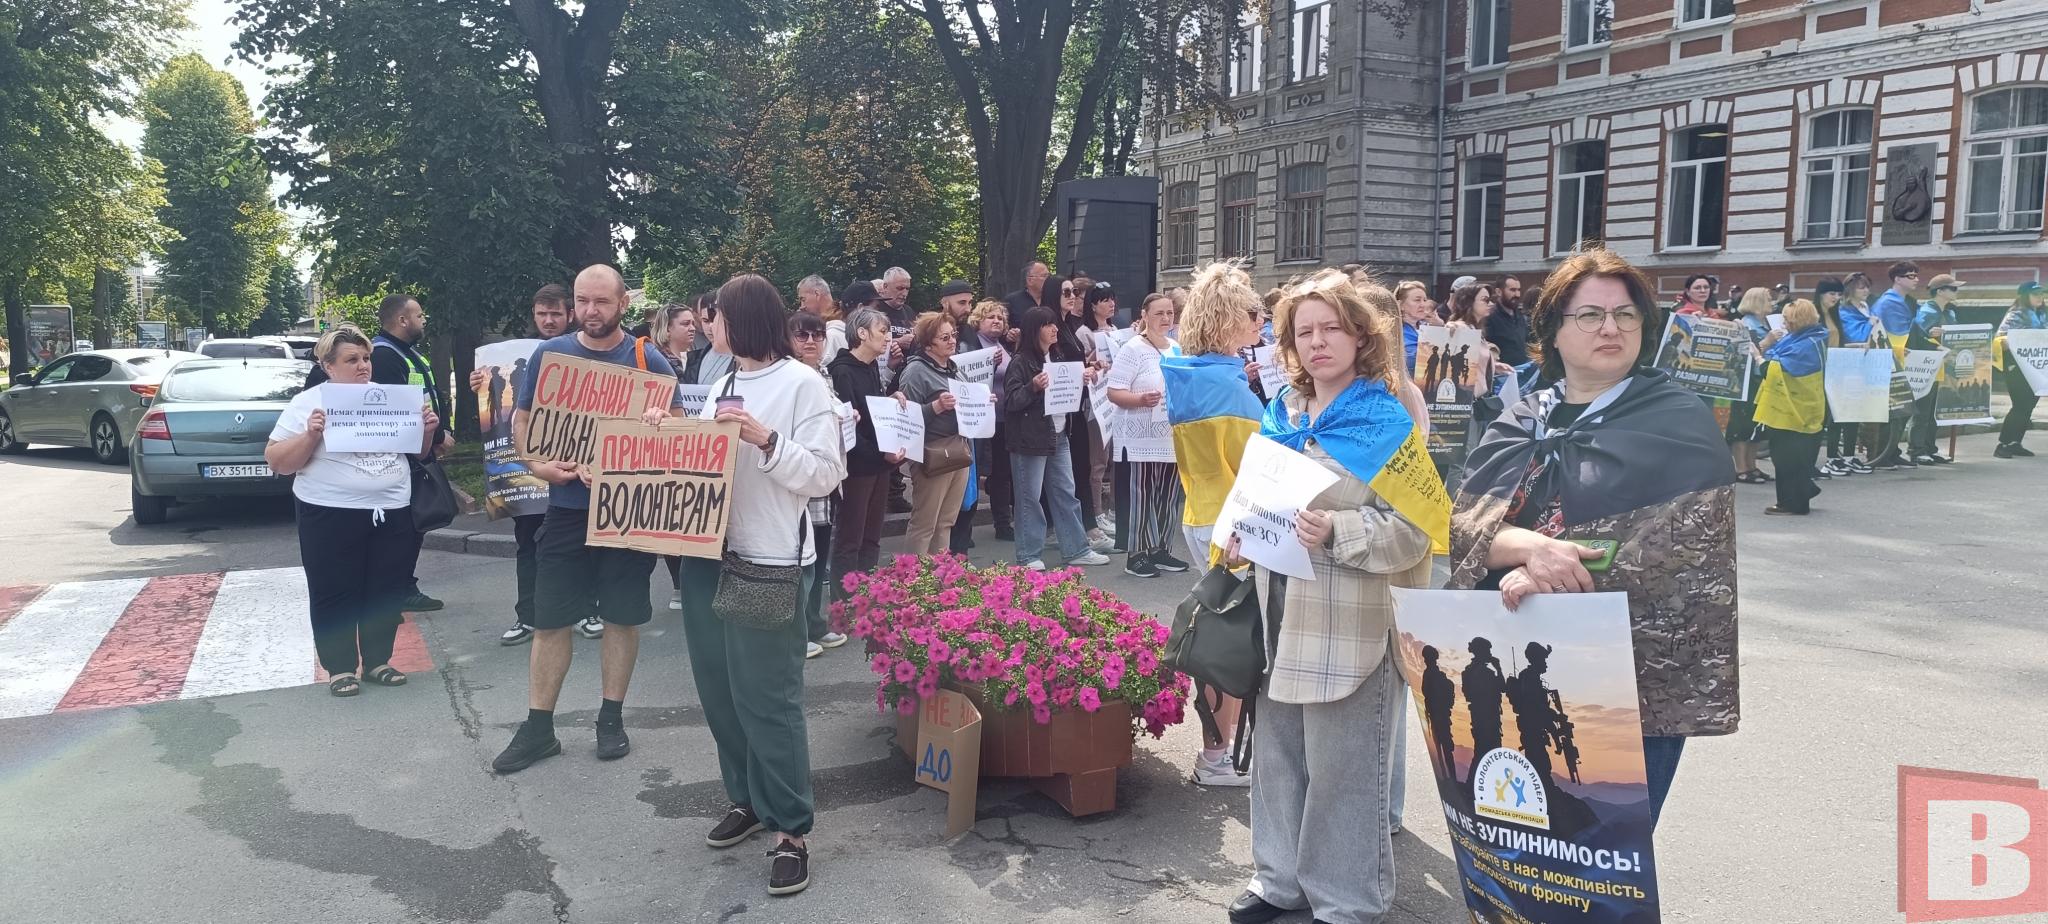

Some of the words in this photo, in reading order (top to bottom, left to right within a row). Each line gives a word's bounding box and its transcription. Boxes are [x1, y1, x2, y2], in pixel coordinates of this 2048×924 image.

[967, 360, 985, 373] день
[537, 362, 634, 418] СИЛЬНИЙ
[326, 408, 354, 416] Немає
[356, 408, 410, 418] приміщення
[360, 421, 399, 429] простору
[354, 430, 399, 438] допомоги!
[484, 440, 495, 451] МИ
[496, 437, 508, 447] НЕ
[498, 456, 522, 464] допом
[602, 433, 729, 473] ПРИМІЩЕННЯ
[210, 466, 226, 476] BX
[229, 466, 253, 476] 3511
[255, 465, 269, 475] ET
[504, 493, 528, 502] щодня
[596, 480, 726, 536] ВОЛОНТЕРАМ
[1248, 502, 1294, 533] допомогу
[1259, 526, 1282, 547] ЗСУ
[925, 696, 951, 728] НЕ
[917, 742, 952, 783] ДО
[1478, 751, 1530, 792] ВОЛОНТЕРСЬКИЙ
[1529, 772, 1544, 804] ЛІДЕР
[1479, 806, 1511, 818] ГРОМАДСЬКА
[1511, 812, 1544, 824] ОРГАНІЗАЦІЯ
[1442, 800, 1459, 825] МИ
[1458, 811, 1476, 836] НЕ
[1476, 821, 1641, 873] ЗУПИНИМОСЬ!
[1502, 860, 1510, 871] в
[1513, 862, 1539, 879] нас
[1543, 869, 1645, 899] можливість
[1531, 883, 1591, 913] фронту
